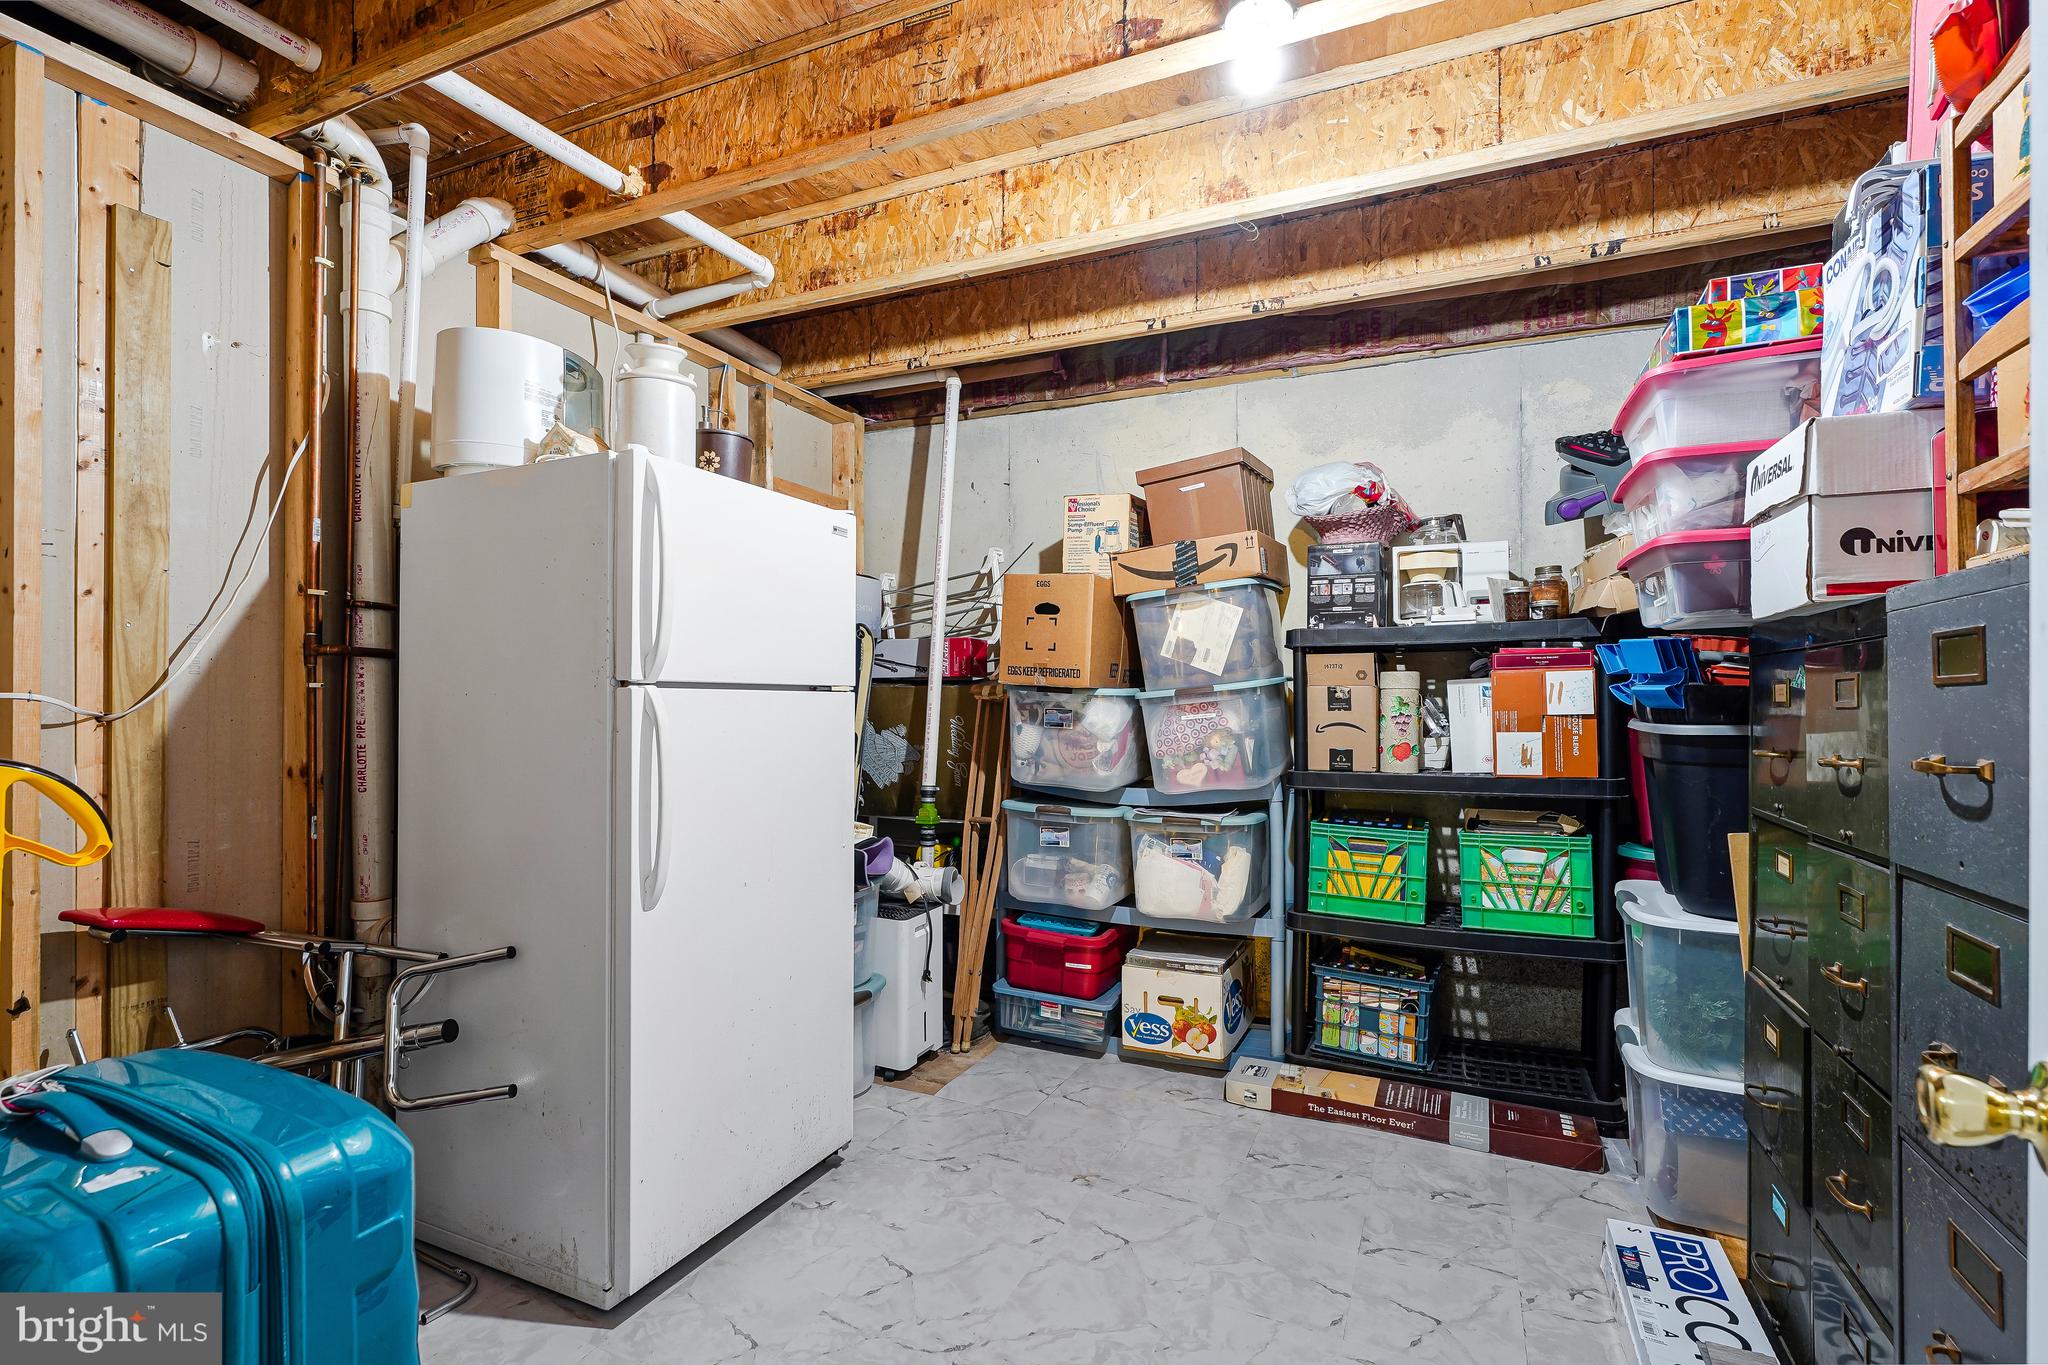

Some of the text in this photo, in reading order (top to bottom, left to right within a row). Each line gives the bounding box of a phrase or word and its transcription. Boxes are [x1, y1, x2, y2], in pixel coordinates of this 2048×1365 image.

[1036, 580, 1051, 588] EGGS
[1007, 665, 1081, 679] EGGS KEEP REFRIGERATED
[356, 719, 367, 739] PIPE
[1572, 735, 1580, 756] BLEND
[356, 743, 368, 793] CHARLOTTE
[1123, 1003, 1141, 1014] Say
[1308, 1102, 1415, 1130] The Easiest Floor Ever!
